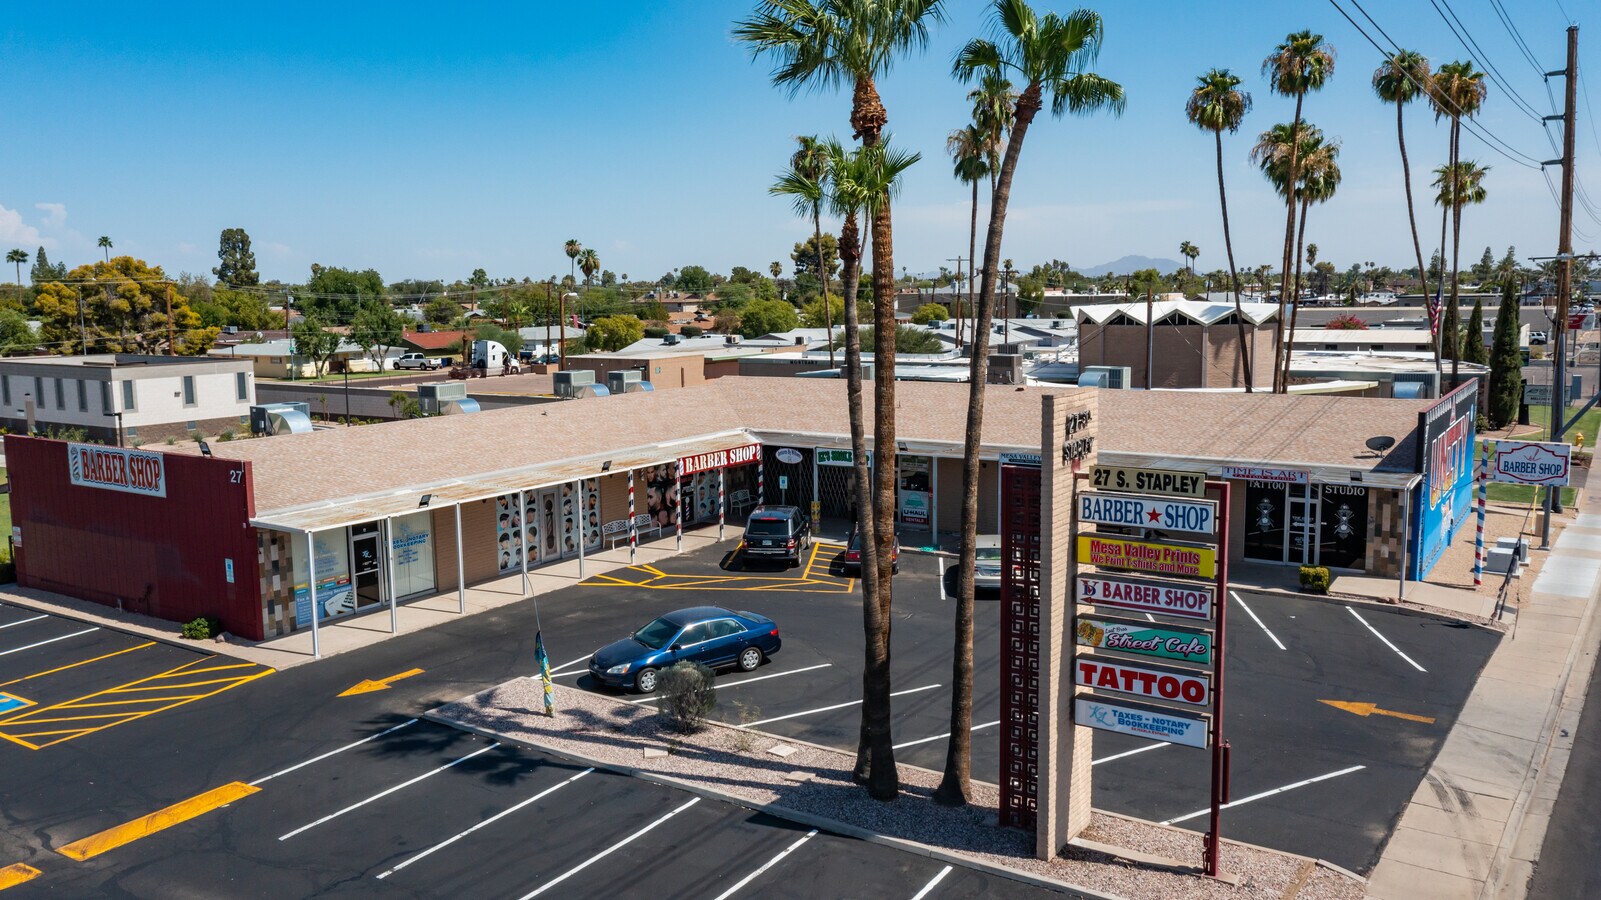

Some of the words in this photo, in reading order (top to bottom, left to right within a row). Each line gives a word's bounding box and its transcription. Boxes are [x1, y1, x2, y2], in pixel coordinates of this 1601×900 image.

[80, 448, 129, 487] BARBER
[129, 454, 161, 491] SHOP
[685, 450, 728, 473] BARBER
[729, 445, 756, 464] SHOP
[1503, 460, 1537, 474] BARBER
[1538, 463, 1562, 476] SHOP
[230, 469, 242, 484] 27
[1094, 469, 1111, 486] 27
[1116, 470, 1130, 488] S.
[1136, 472, 1200, 494] STAPLEY
[1224, 466, 1257, 475] TIME
[1278, 470, 1308, 479] ART
[1248, 480, 1285, 490] TATTOO
[1325, 485, 1365, 497] STUDIO
[1082, 497, 1144, 525] BARBER
[1165, 504, 1210, 531] SHOP
[393, 539, 427, 550] OOKKEEPING
[1090, 540, 1121, 555] Mesa
[1124, 543, 1161, 560] Valley
[1164, 548, 1200, 565] Prints
[1091, 553, 1103, 563] We
[1106, 555, 1124, 565] Print
[1127, 558, 1157, 569] T-shirts
[1159, 562, 1174, 572] and
[1177, 564, 1199, 574] More
[1102, 582, 1160, 605] BARBER
[1164, 589, 1208, 610] SHOP
[1106, 632, 1163, 650] Street
[1165, 637, 1207, 658] Cafe
[1080, 662, 1205, 703] TATTOO
[1111, 709, 1143, 721] TAXES
[1152, 716, 1191, 730] NOTARY
[1118, 718, 1185, 736] BOOKKEEPING
